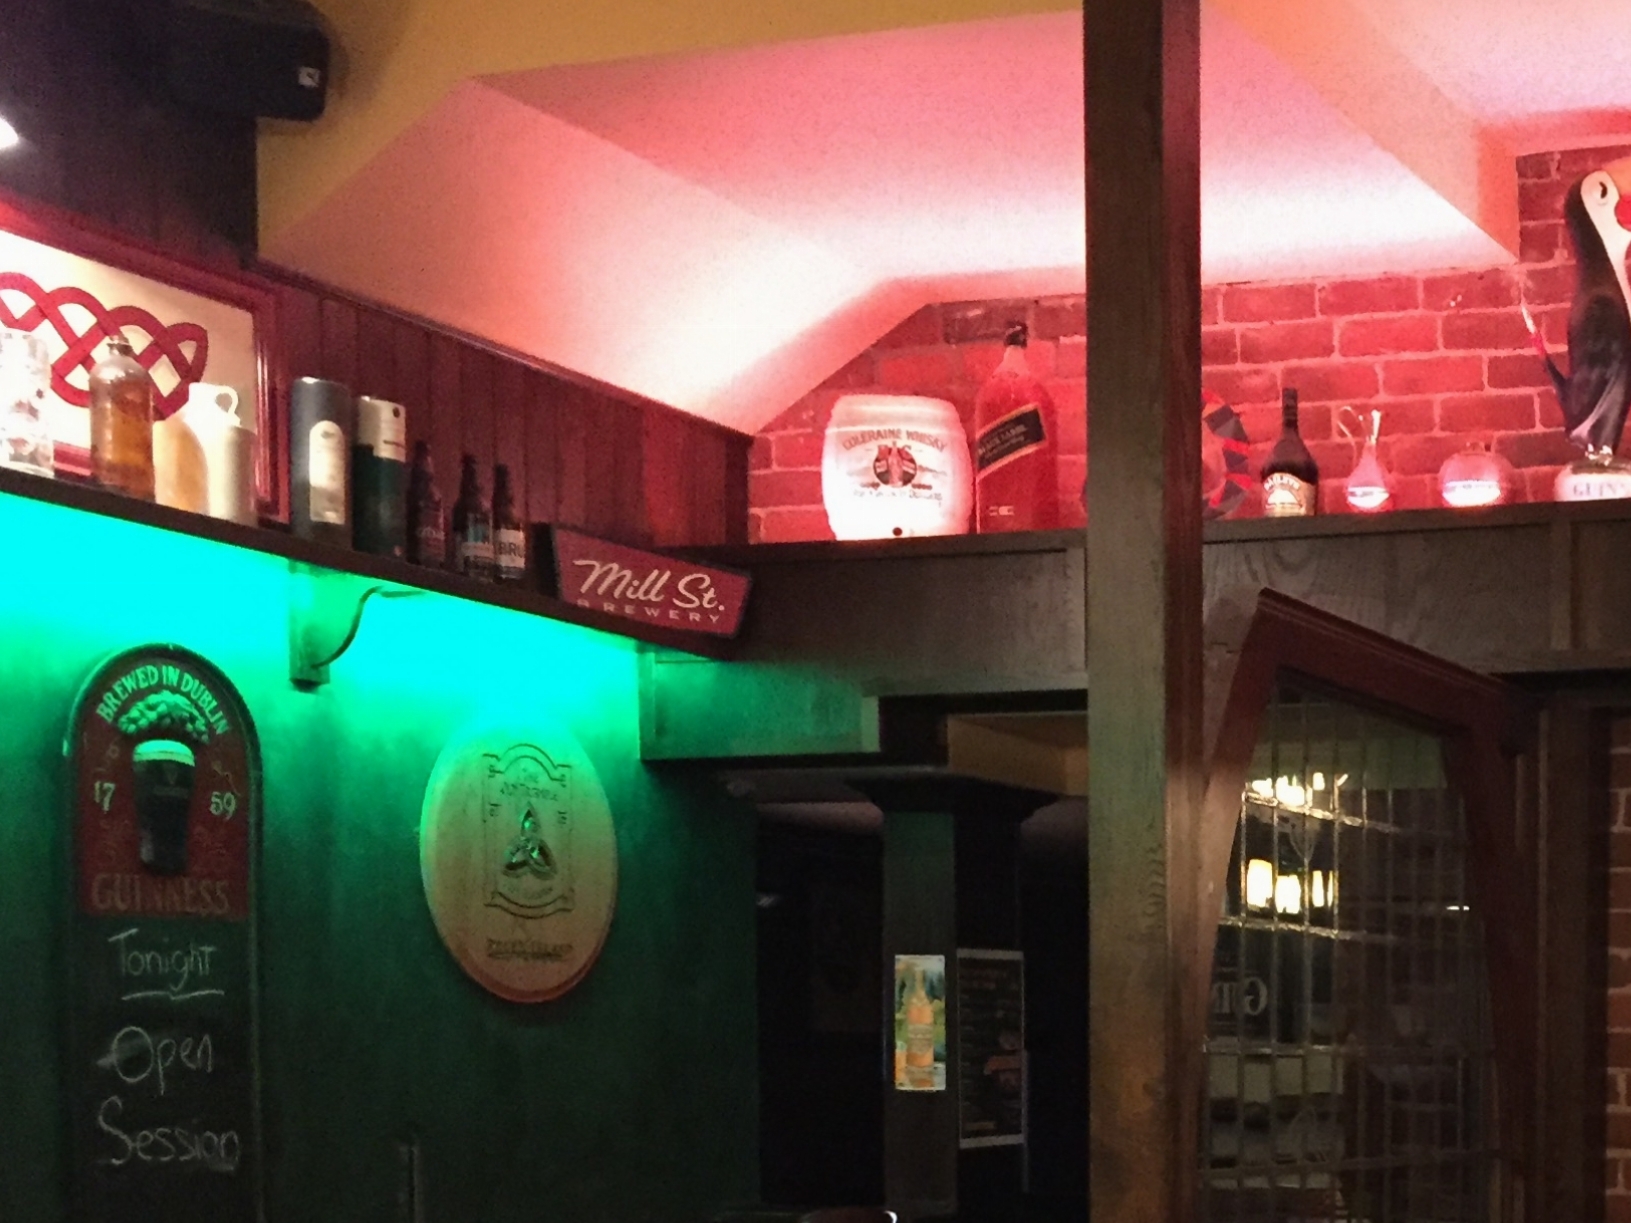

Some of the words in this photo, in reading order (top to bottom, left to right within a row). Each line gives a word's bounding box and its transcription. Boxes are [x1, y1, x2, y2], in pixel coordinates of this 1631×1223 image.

[572, 559, 672, 602] Mill
[672, 573, 725, 612] St.
[577, 598, 720, 625] BREWERY
[96, 664, 159, 723] BREWED
[162, 665, 180, 687] IN
[180, 672, 230, 735] DUBLIN
[94, 780, 116, 814] 17
[209, 791, 237, 821] 59
[91, 872, 231, 915] GUINNESS
[107, 928, 217, 991] Tonight
[111, 1025, 213, 1096] Open
[97, 1095, 240, 1168] Session
